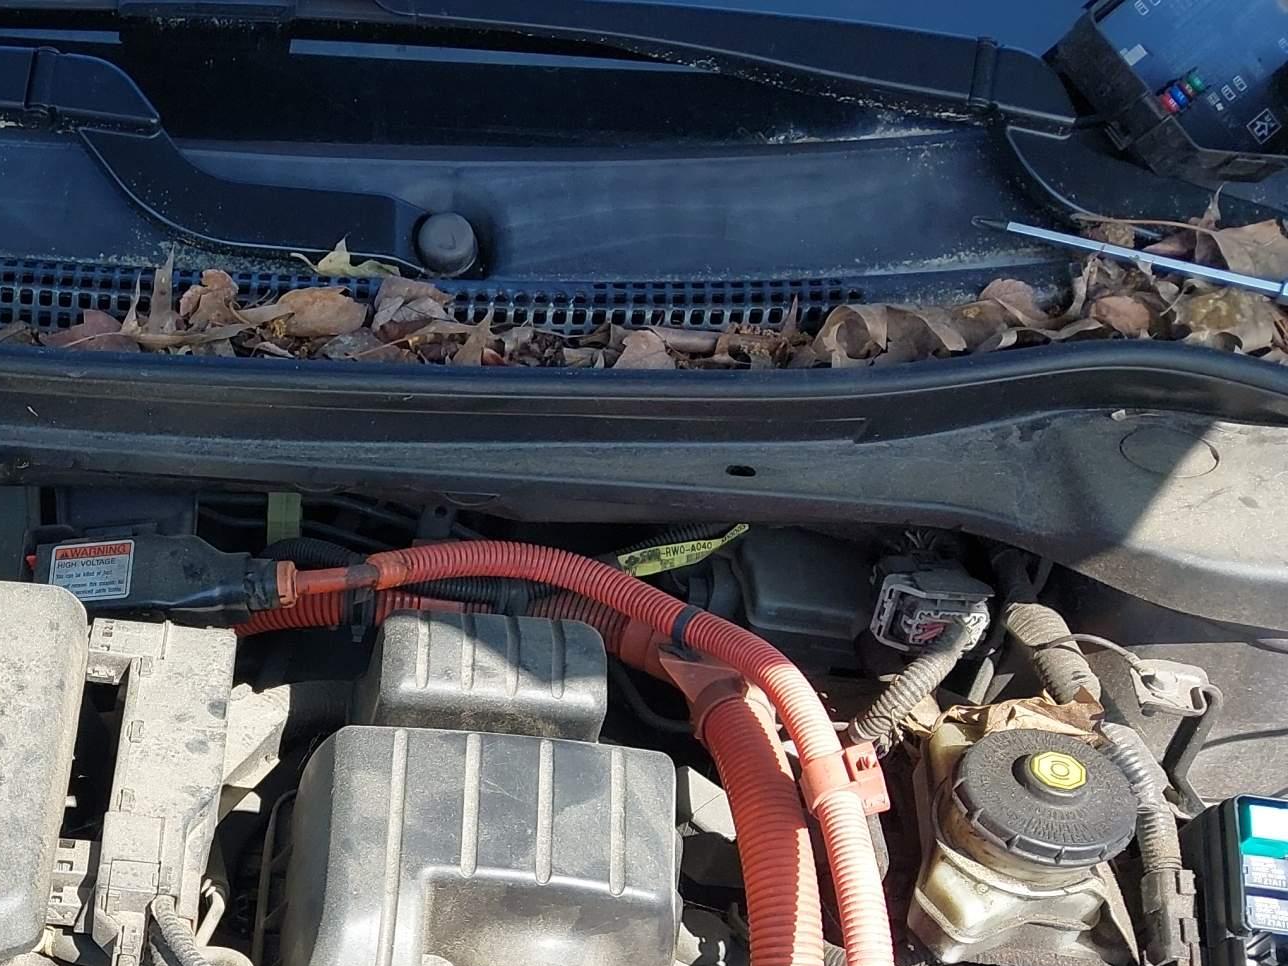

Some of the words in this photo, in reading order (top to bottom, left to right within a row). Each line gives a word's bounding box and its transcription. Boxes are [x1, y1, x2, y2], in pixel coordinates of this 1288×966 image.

[70, 544, 125, 557] WARNING
[57, 561, 77, 569] HIGH
[80, 558, 116, 567] VOLTAGE
